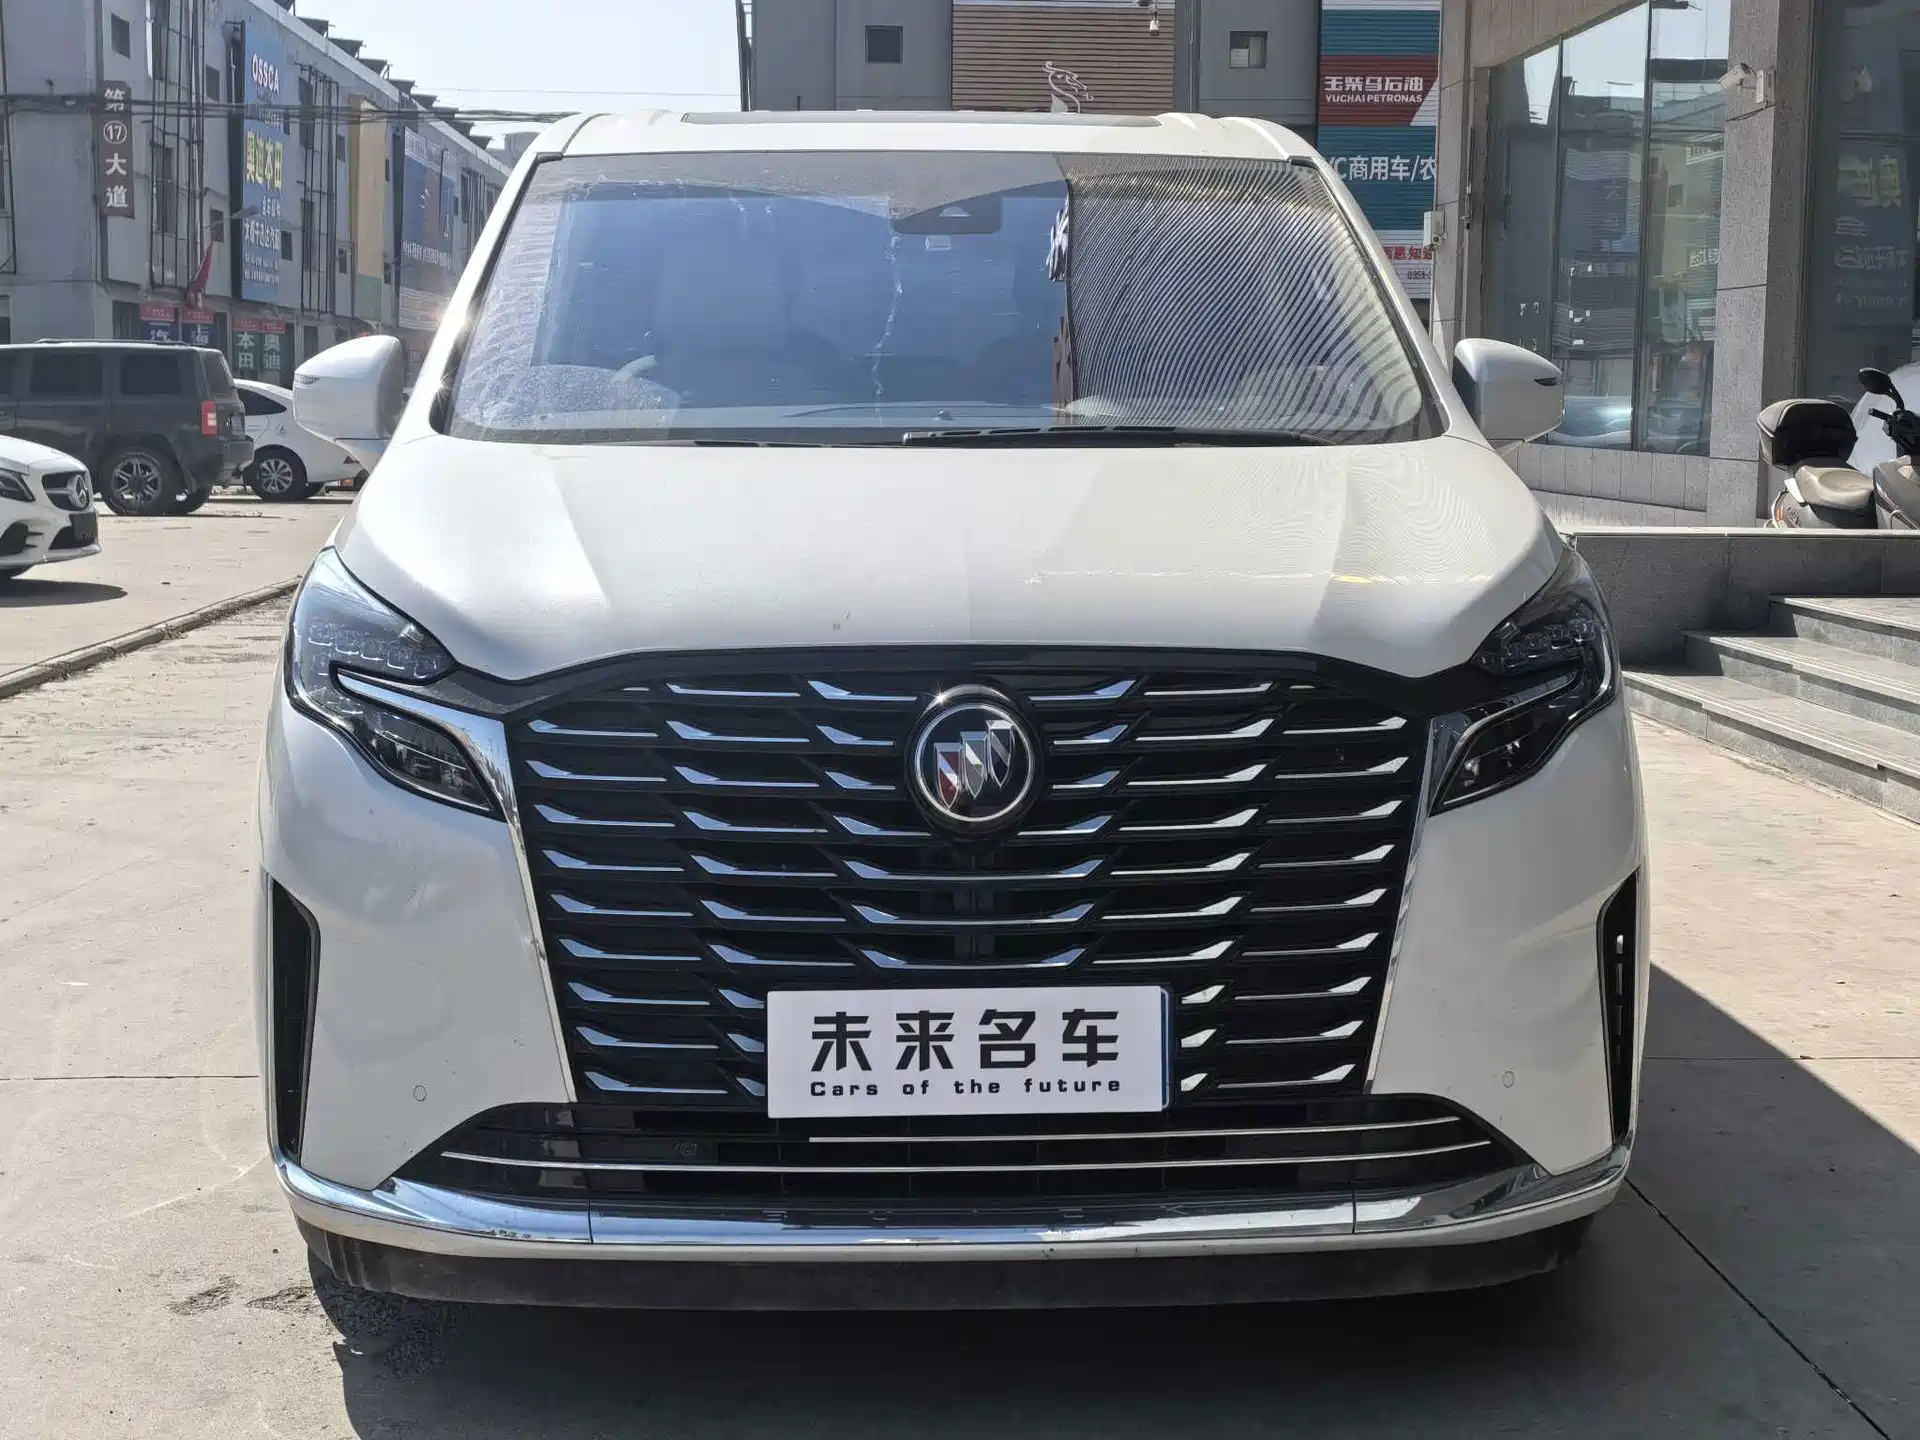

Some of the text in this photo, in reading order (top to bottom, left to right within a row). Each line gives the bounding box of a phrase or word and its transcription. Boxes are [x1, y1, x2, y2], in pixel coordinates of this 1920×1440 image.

[1325, 94, 1423, 103] YUCHAI PETRONAS
[236, 332, 255, 370] 本田
[810, 1008, 1120, 1072] 未来名车
[810, 1077, 1121, 1097] Cars of the future
